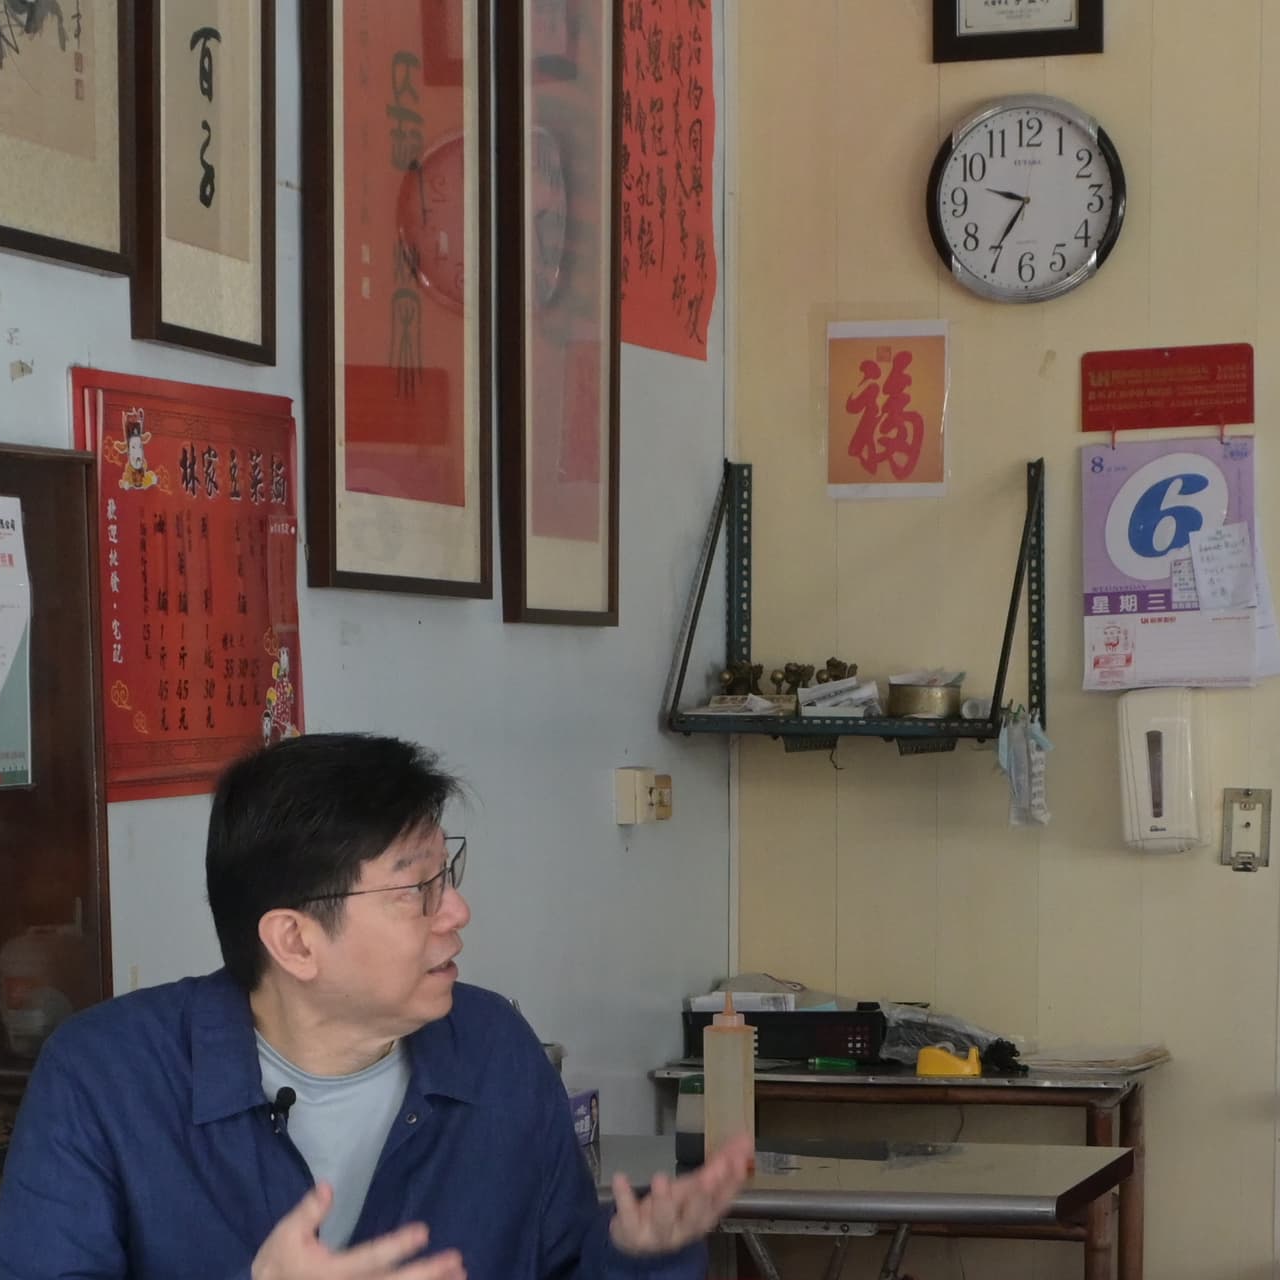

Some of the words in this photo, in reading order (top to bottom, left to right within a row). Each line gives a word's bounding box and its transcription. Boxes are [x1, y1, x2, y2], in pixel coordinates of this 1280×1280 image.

[988, 129, 1007, 158] 11
[1017, 117, 1042, 148] 12
[1056, 126, 1064, 156] 1
[961, 152, 986, 182] 10
[1075, 149, 1093, 178] 2
[951, 187, 968, 218] 9
[1086, 184, 1104, 214] 3
[963, 222, 980, 251] 8
[1074, 219, 1092, 248] 4
[988, 245, 1004, 273] 7
[1017, 252, 1035, 282] 6
[1049, 244, 1067, 272] 5
[845, 350, 925, 480] 福
[179, 441, 289, 507] 林家豆菜麵
[1091, 456, 1105, 474] 8
[1127, 473, 1210, 558] 6
[1091, 593, 1166, 613] 星期三
